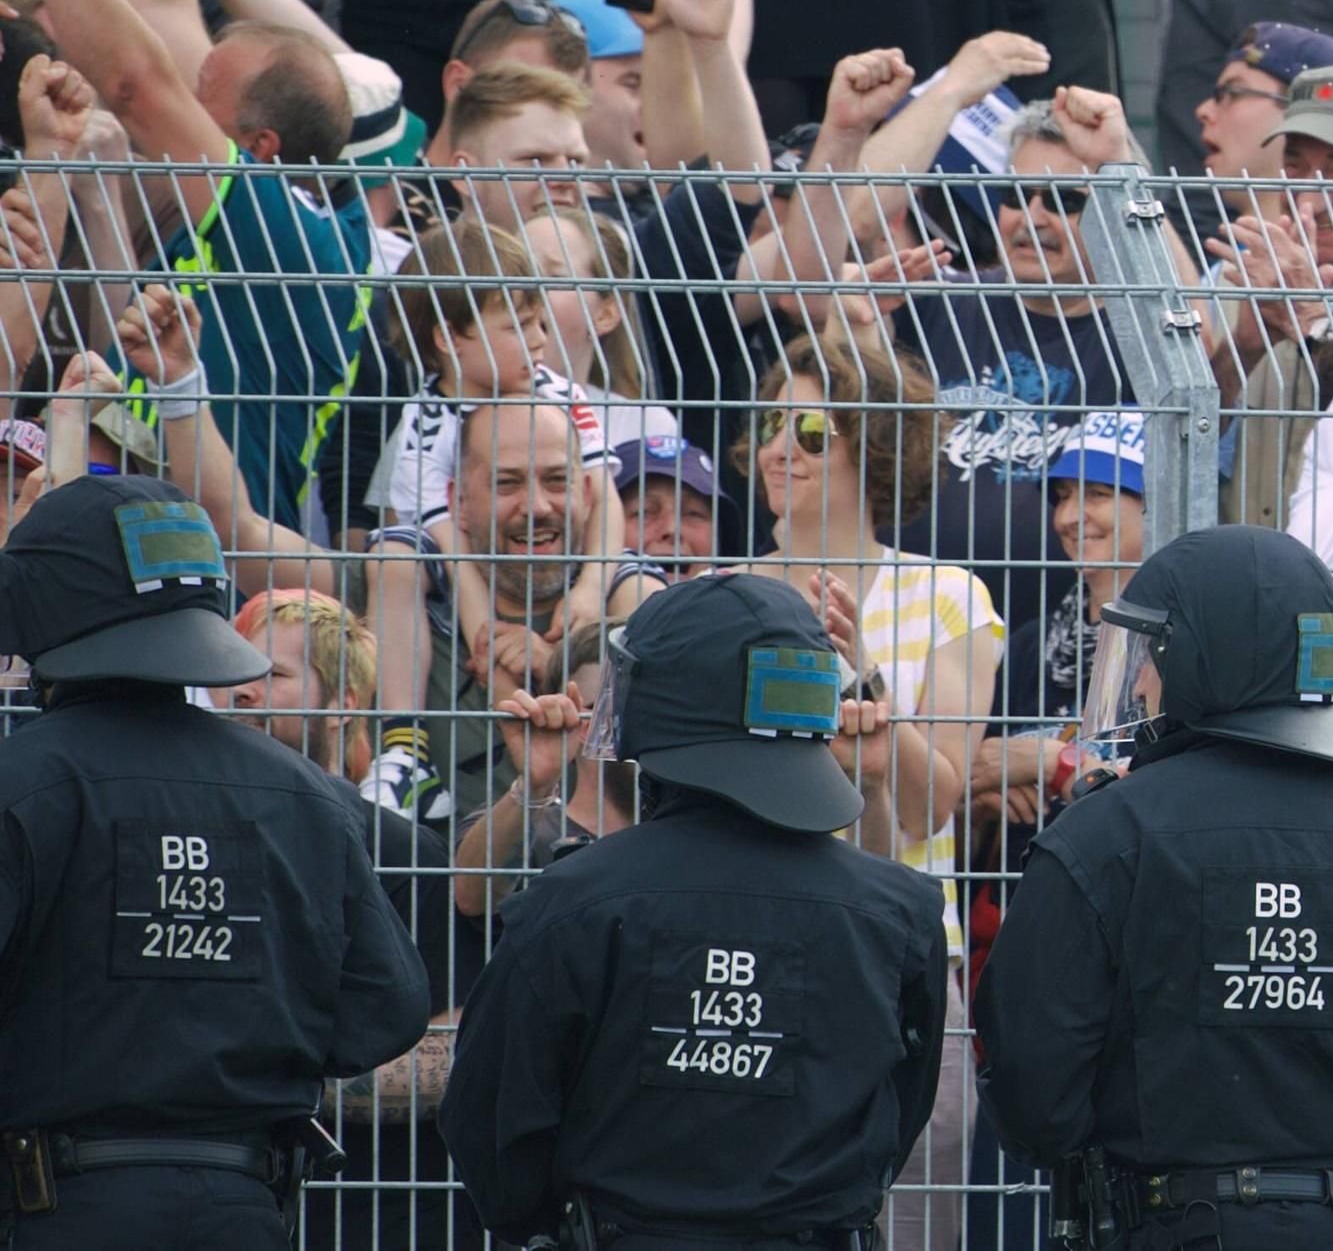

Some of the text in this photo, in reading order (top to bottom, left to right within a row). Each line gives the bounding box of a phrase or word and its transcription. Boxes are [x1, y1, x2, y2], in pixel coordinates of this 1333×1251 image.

[161, 835, 210, 871] BB
[156, 874, 225, 912] 1433
[1255, 882, 1301, 918] BB
[142, 922, 233, 961] 21242
[1246, 926, 1317, 963] 1433
[705, 948, 756, 986] BB
[690, 990, 762, 1027] 1433
[1223, 975, 1325, 1011] 27964
[667, 1038, 773, 1079] 44867
